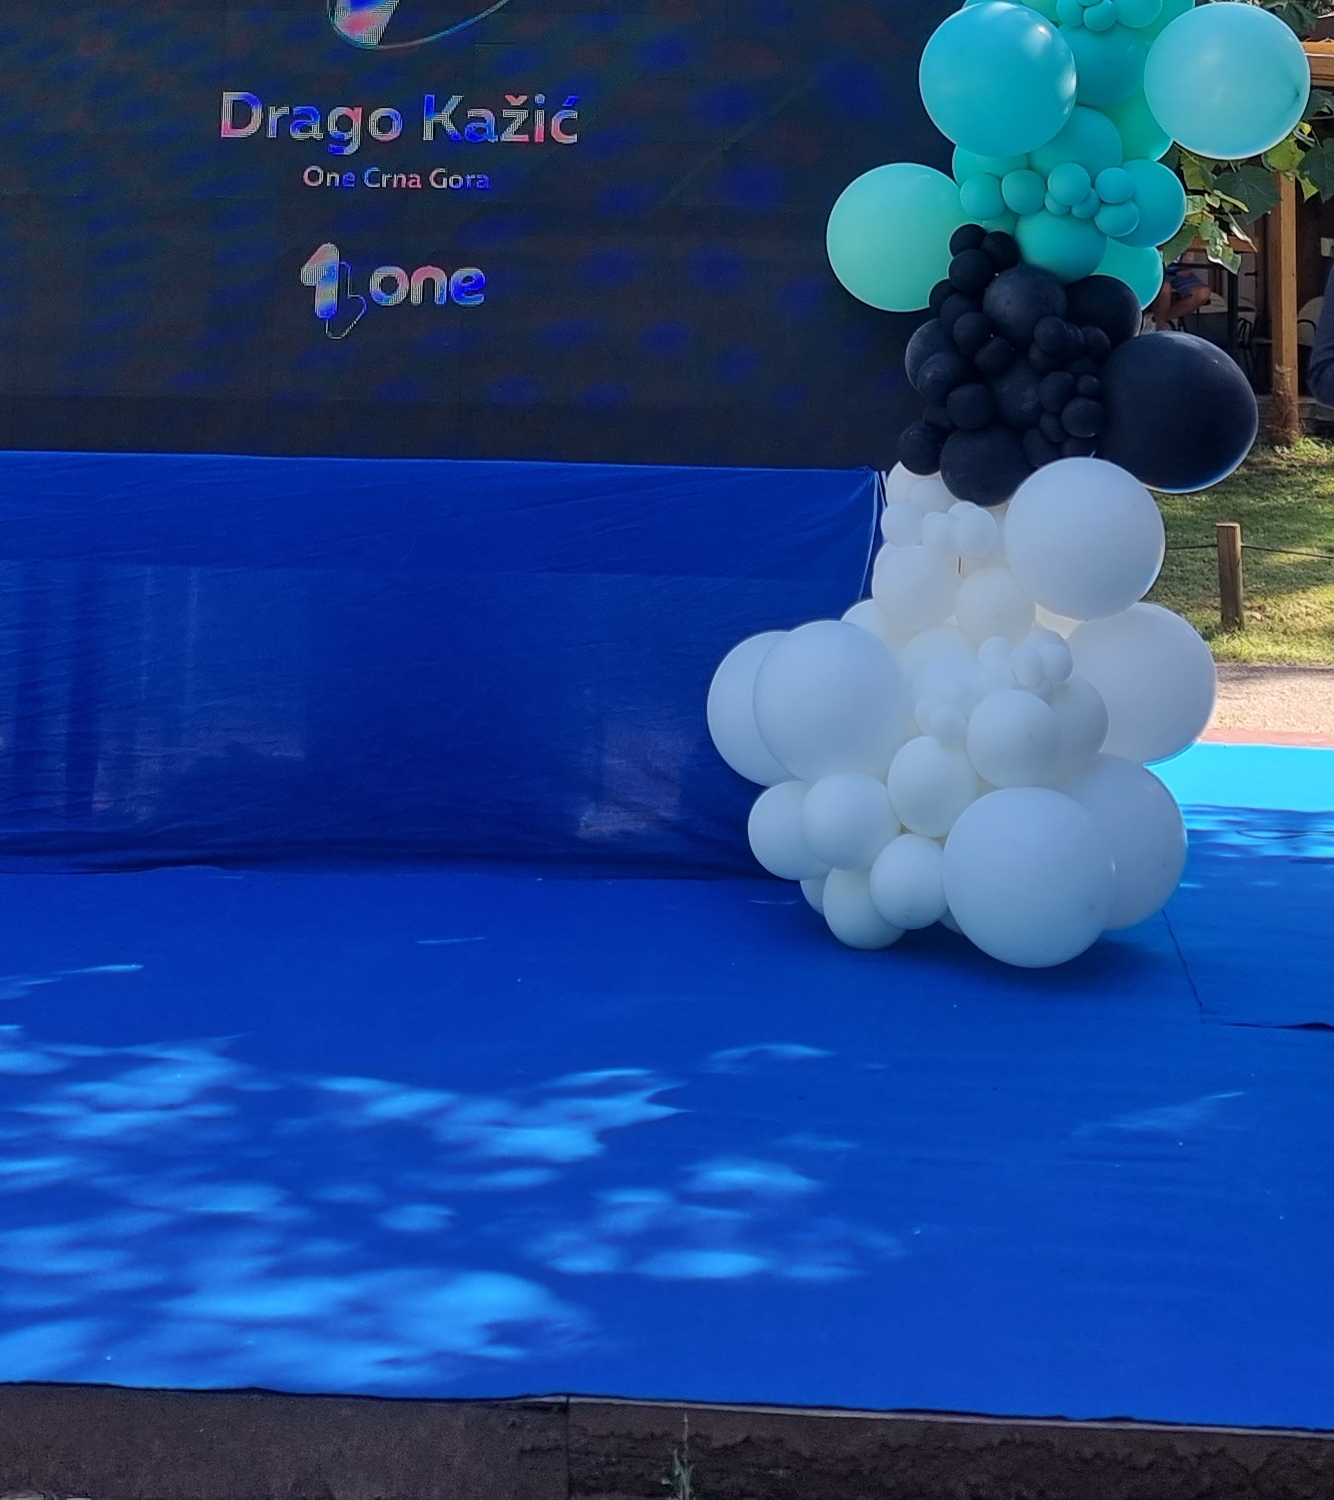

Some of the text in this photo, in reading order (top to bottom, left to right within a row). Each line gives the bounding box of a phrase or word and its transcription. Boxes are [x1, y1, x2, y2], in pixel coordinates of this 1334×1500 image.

[220, 91, 579, 156] Drago Kažić
[302, 165, 492, 190] One Crna Gora
[369, 265, 486, 307] one
